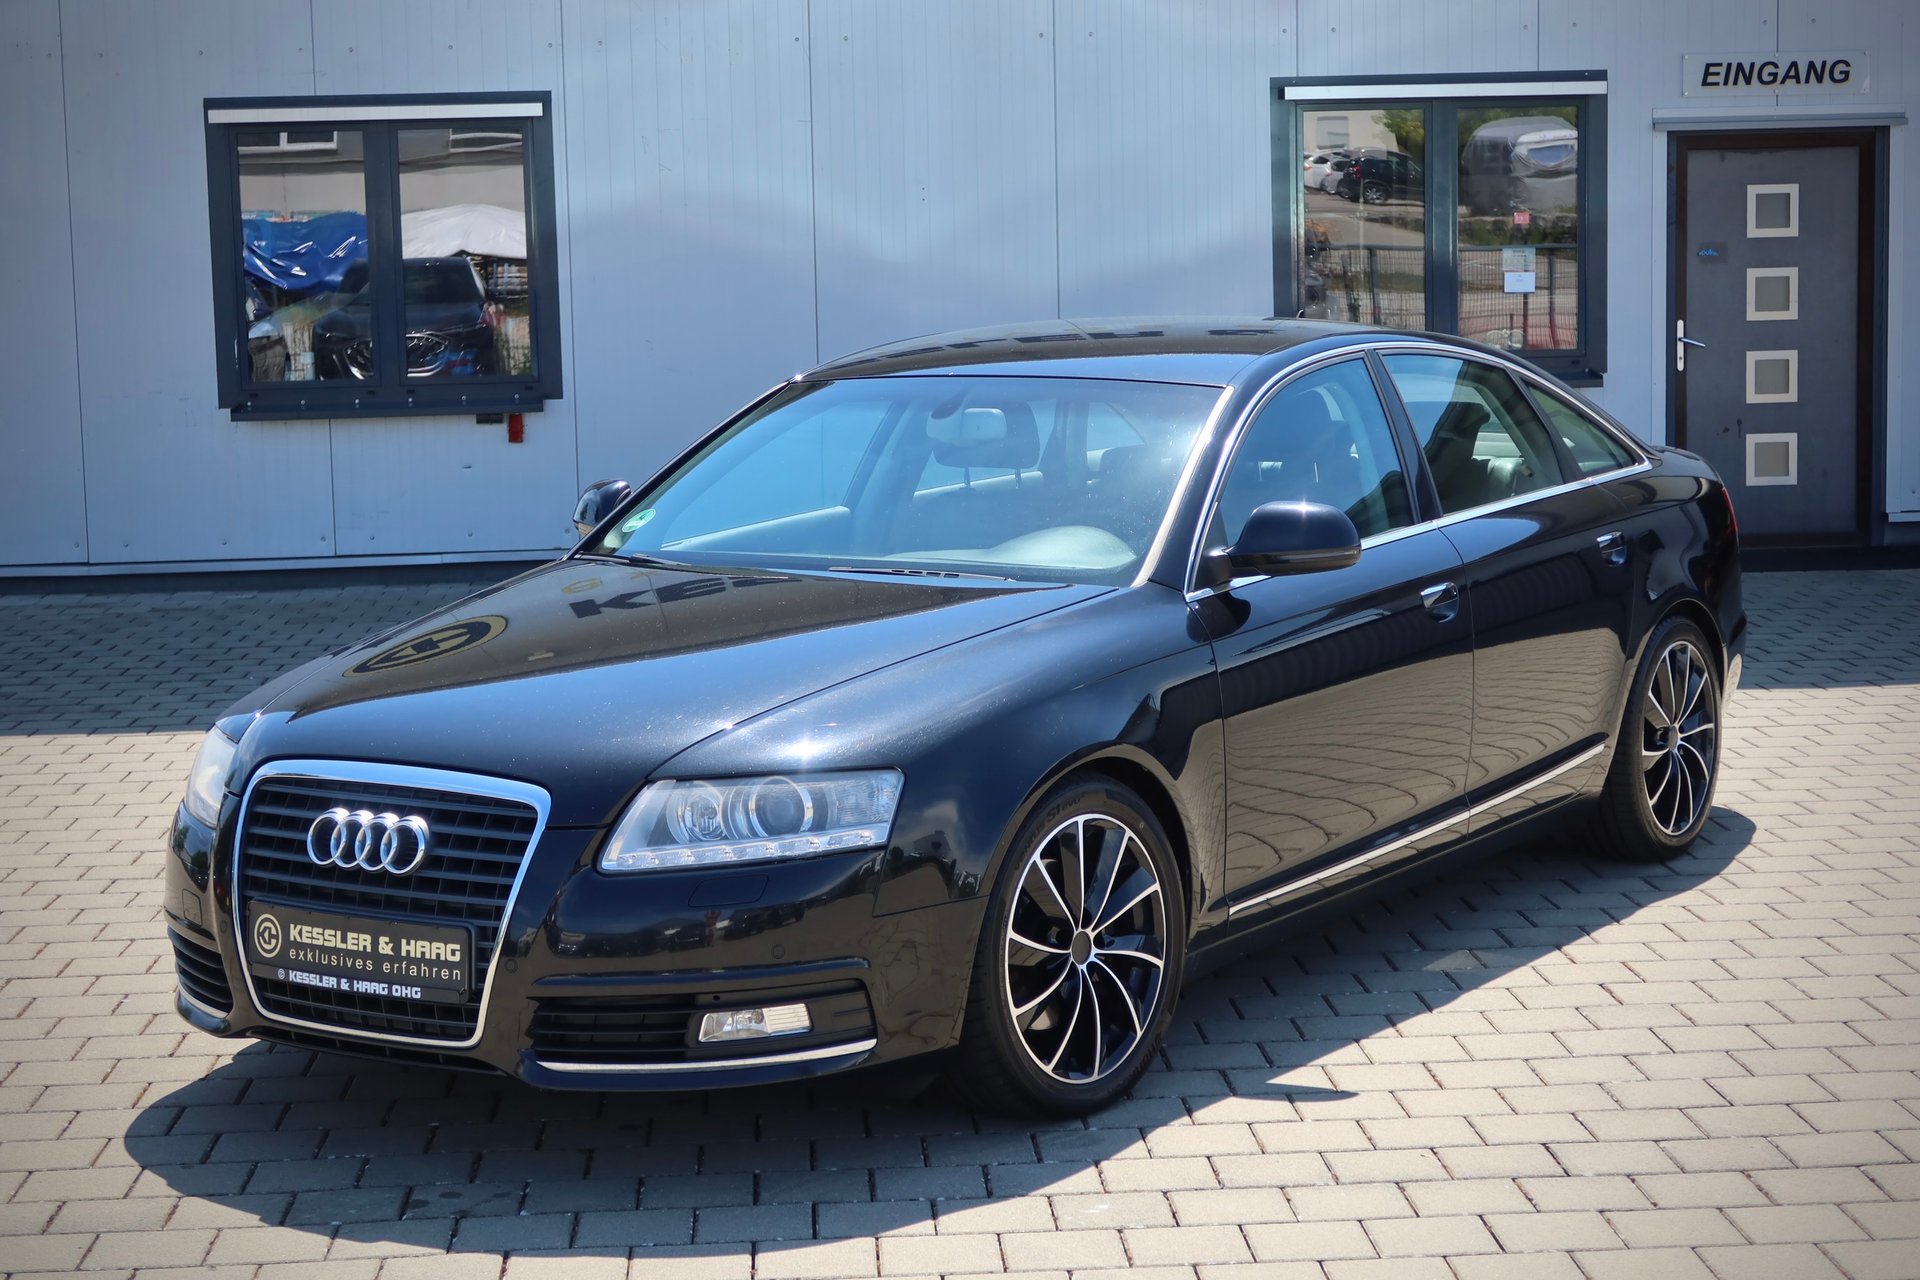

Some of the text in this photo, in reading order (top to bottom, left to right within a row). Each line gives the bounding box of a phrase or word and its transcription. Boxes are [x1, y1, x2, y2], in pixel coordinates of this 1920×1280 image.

[1701, 59, 1851, 87] EINGANG
[289, 923, 461, 963] KESSLER & HAAG
[289, 948, 461, 981] exklusives erfahren
[288, 970, 421, 999] KESSLER & HAAG OHG
